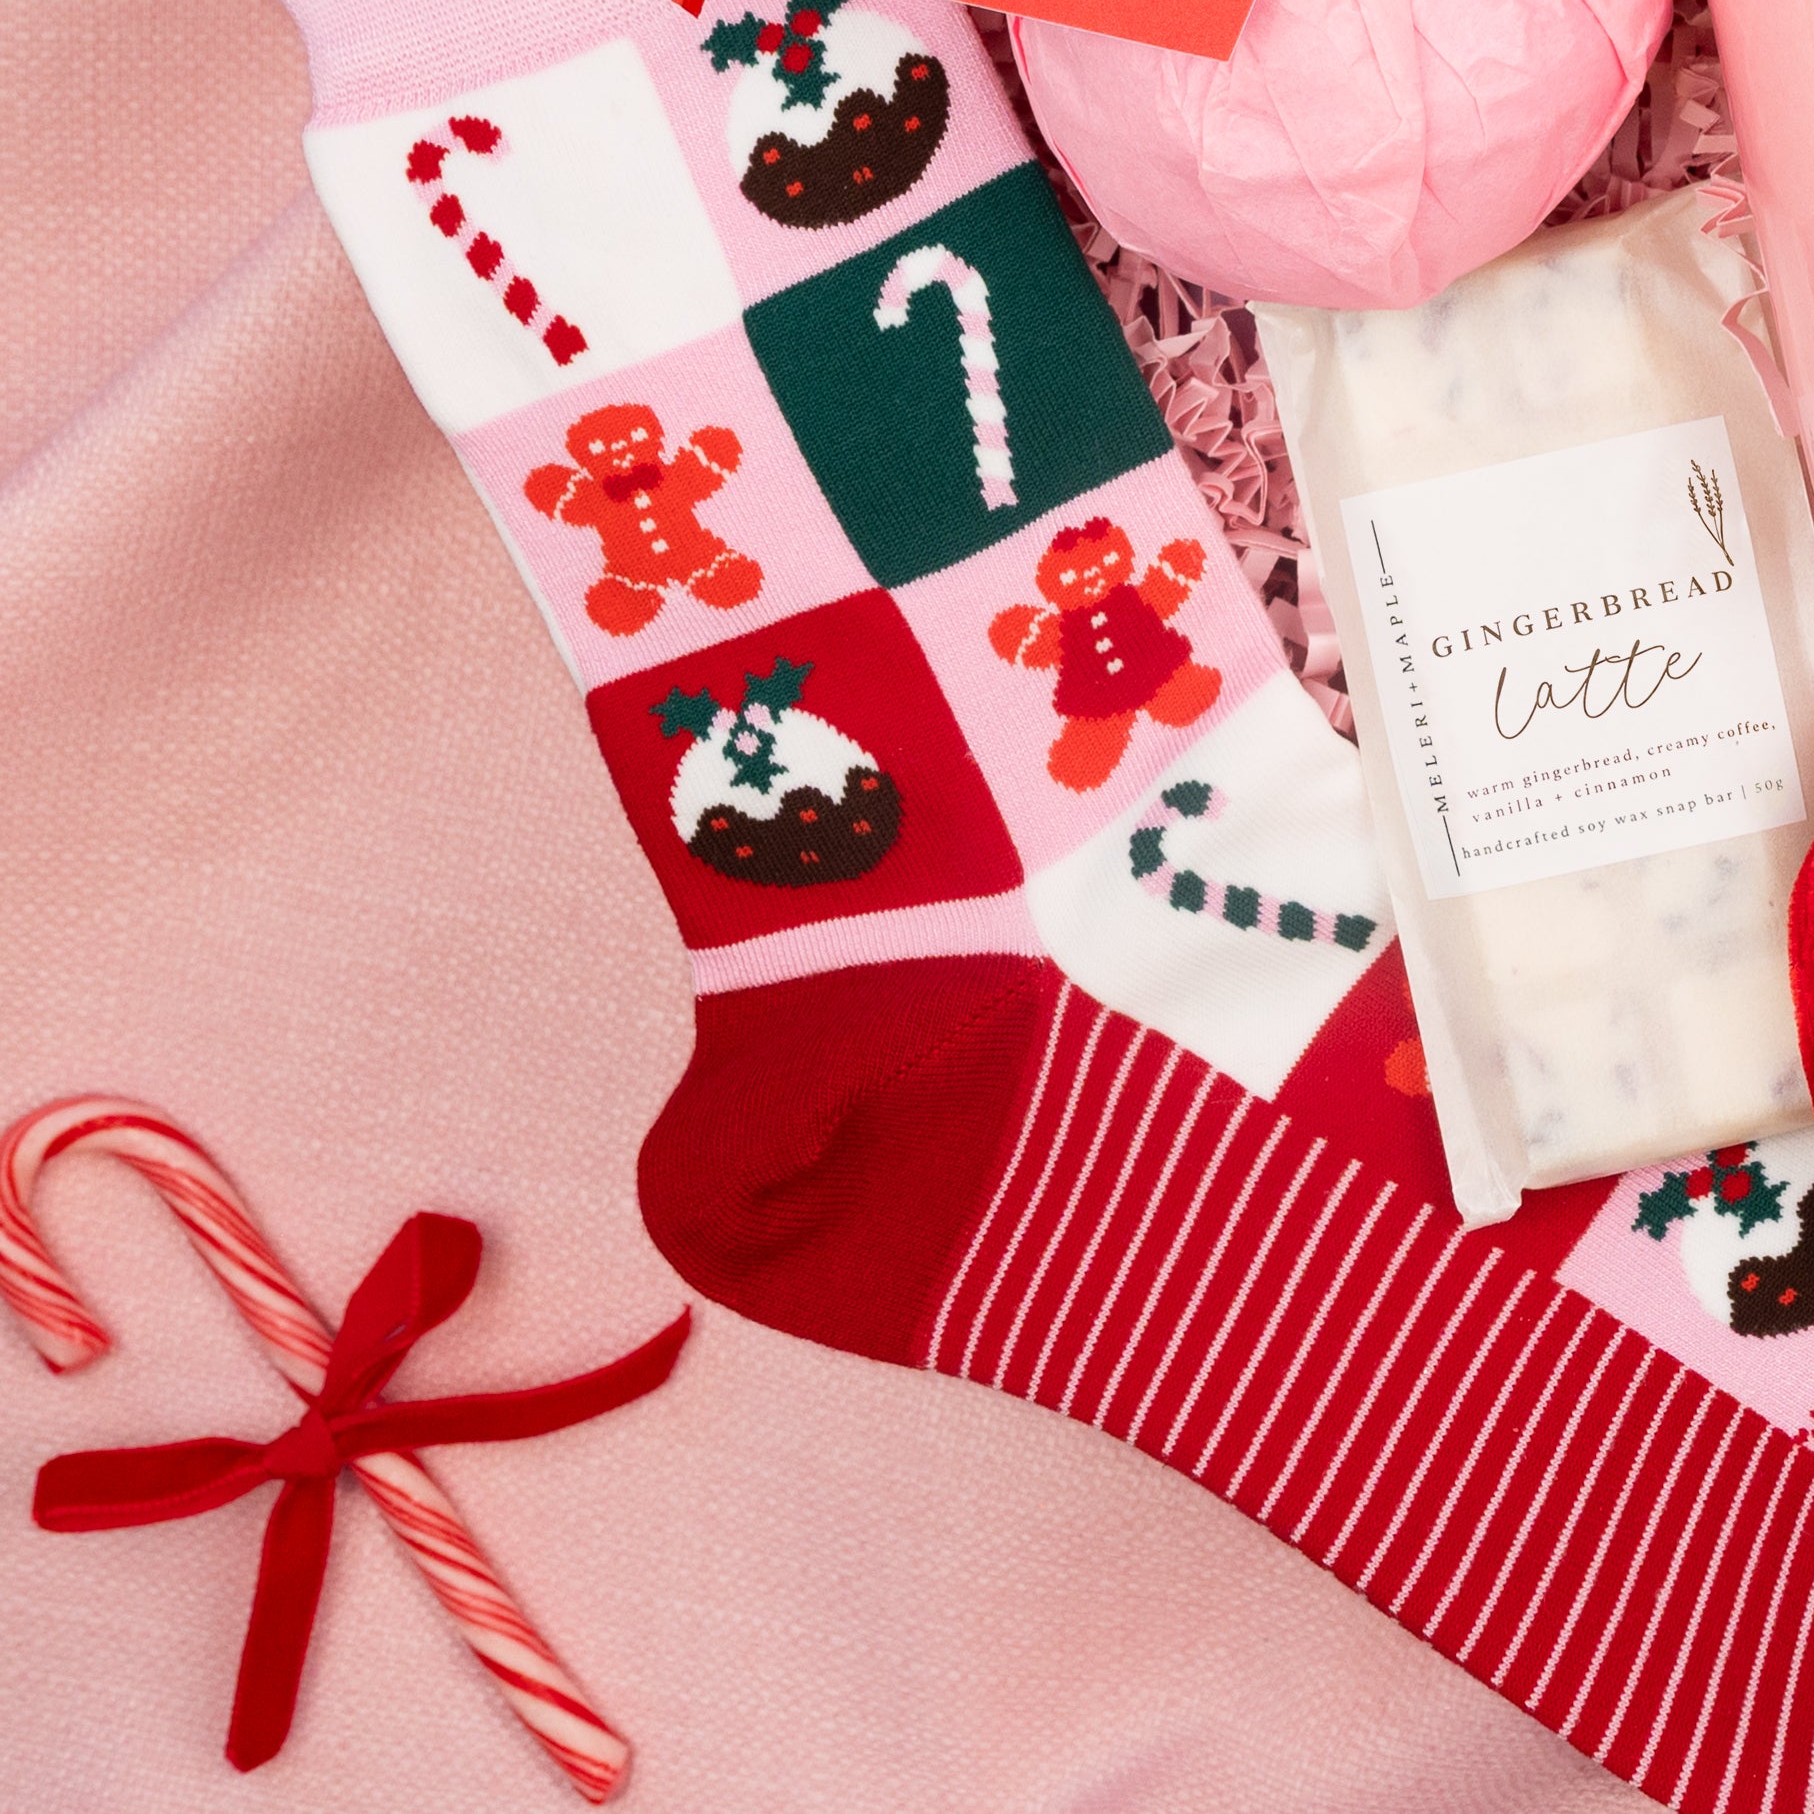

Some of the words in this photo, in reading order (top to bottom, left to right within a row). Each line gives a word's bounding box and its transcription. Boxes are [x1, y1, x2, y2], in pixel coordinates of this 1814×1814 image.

[1431, 570, 1734, 659] GINGERBREAD
[1494, 639, 1702, 739] latte
[1467, 779, 1514, 799] warm
[1522, 749, 1640, 789] gingerbread,
[1647, 733, 1709, 756] creamy
[1717, 720, 1776, 740] coffee,
[1472, 794, 1543, 823] vanilla
[1574, 766, 1672, 798] cinnamon
[1462, 825, 1570, 859] handcrafted
[1578, 818, 1607, 834] soy
[1615, 810, 1648, 826] wax
[1656, 798, 1697, 817] snap
[1704, 790, 1734, 806] bar
[1754, 778, 1785, 793] 50g
